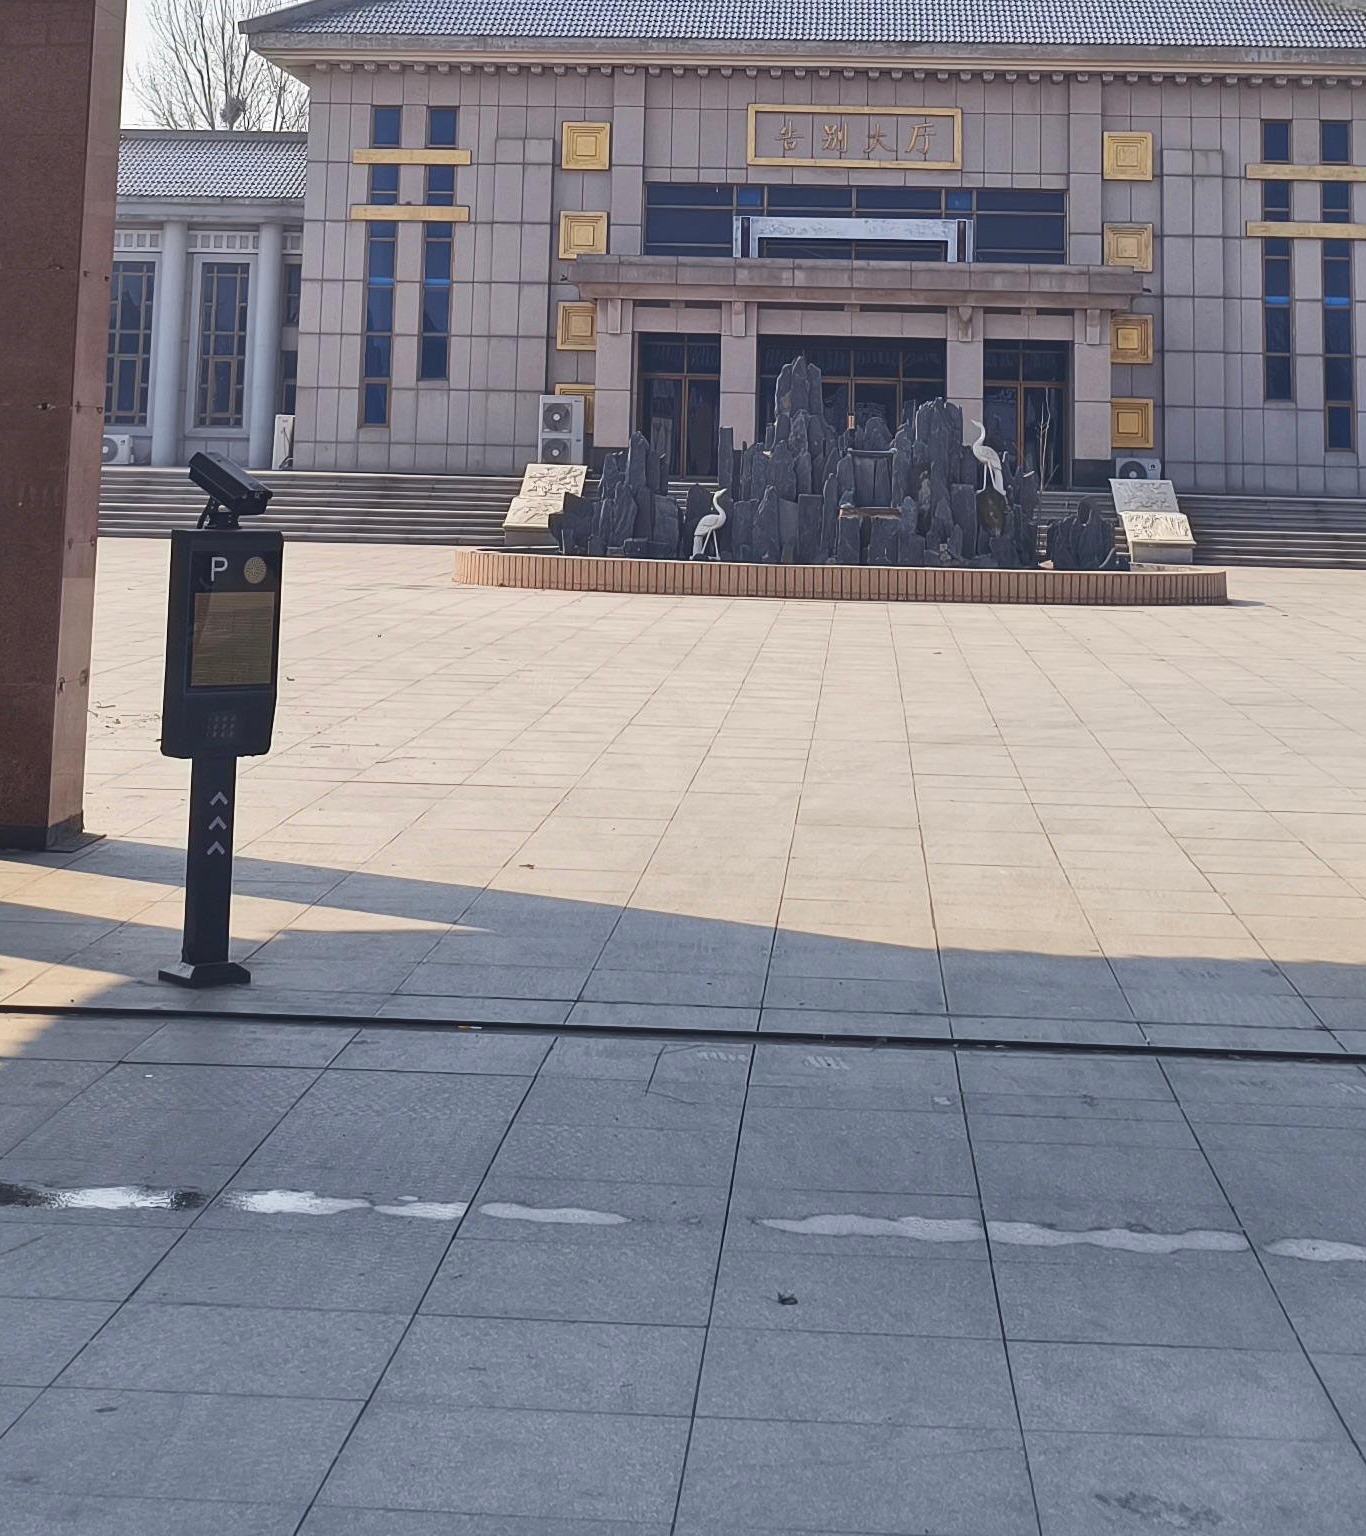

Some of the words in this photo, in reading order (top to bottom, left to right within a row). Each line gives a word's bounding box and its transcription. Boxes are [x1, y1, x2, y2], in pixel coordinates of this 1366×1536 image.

[774, 119, 937, 154] 告别大厅
[210, 556, 229, 583] P
